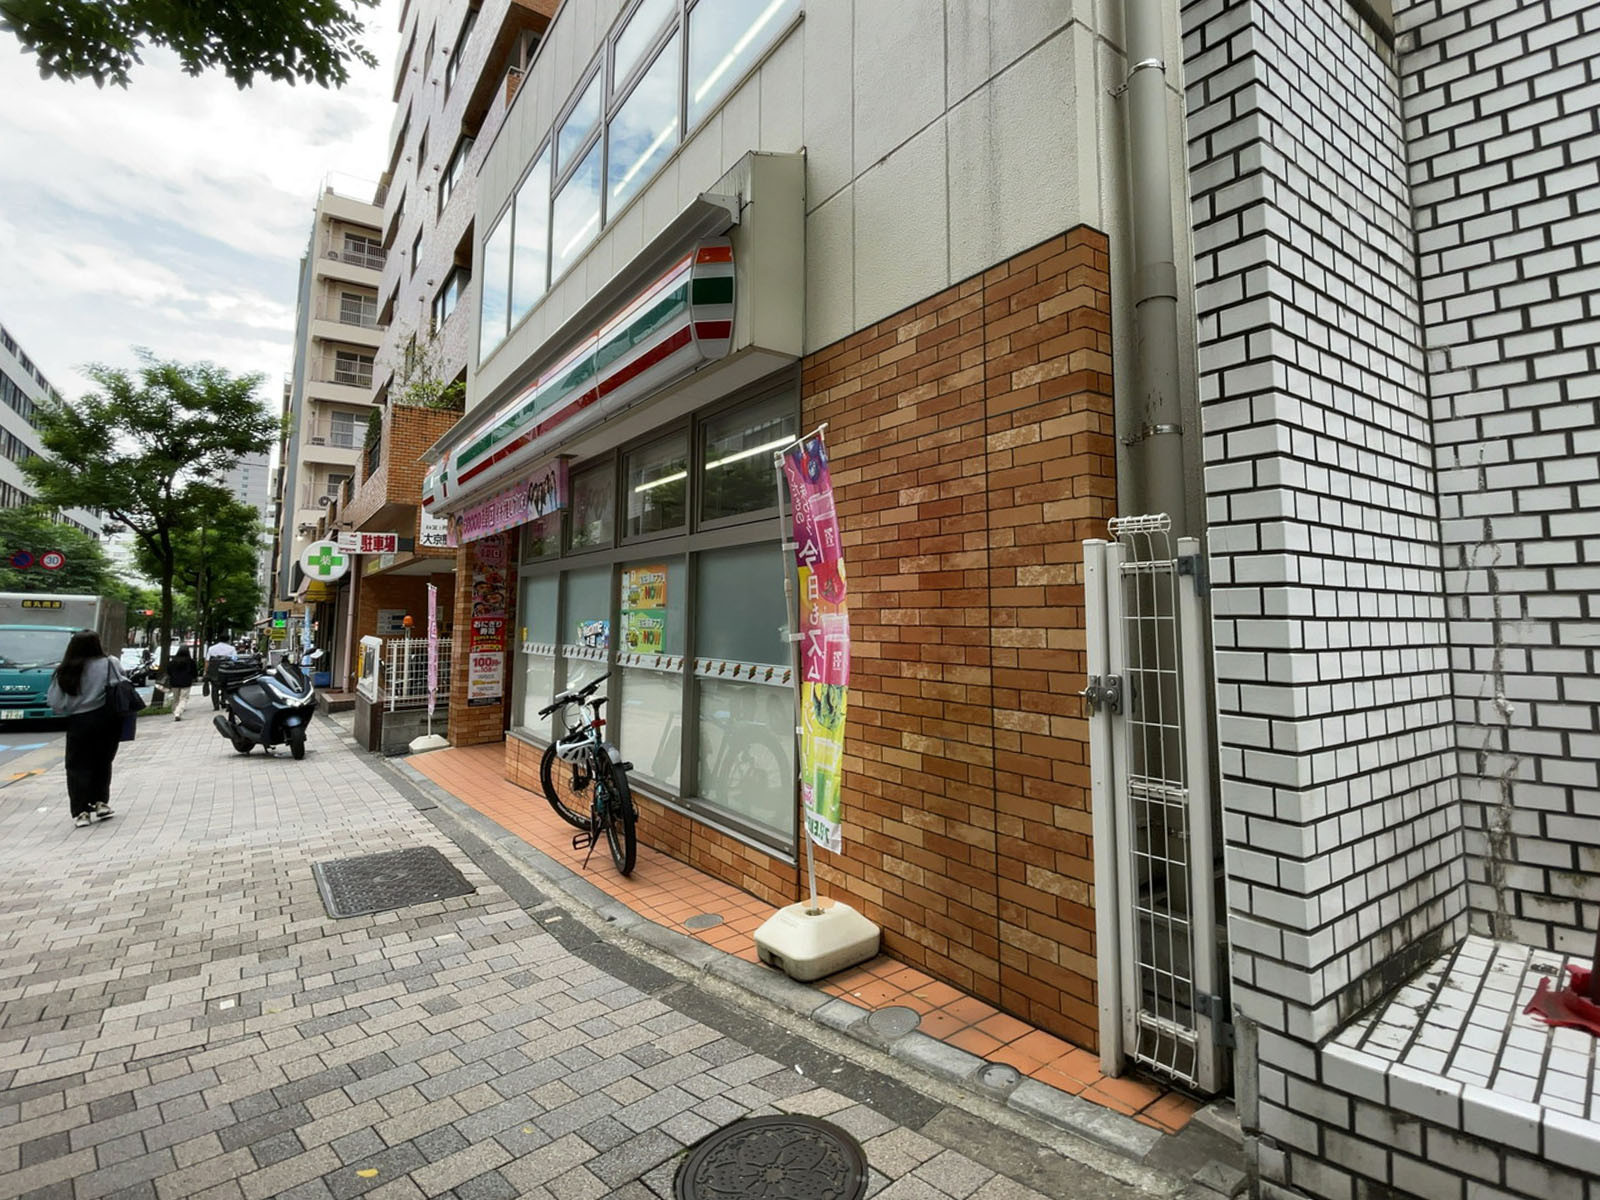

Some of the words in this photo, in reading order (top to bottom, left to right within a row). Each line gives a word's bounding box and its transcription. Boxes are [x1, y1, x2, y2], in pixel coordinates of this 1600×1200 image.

[361, 534, 396, 552] 駐車場
[46, 556, 59, 565] 30
